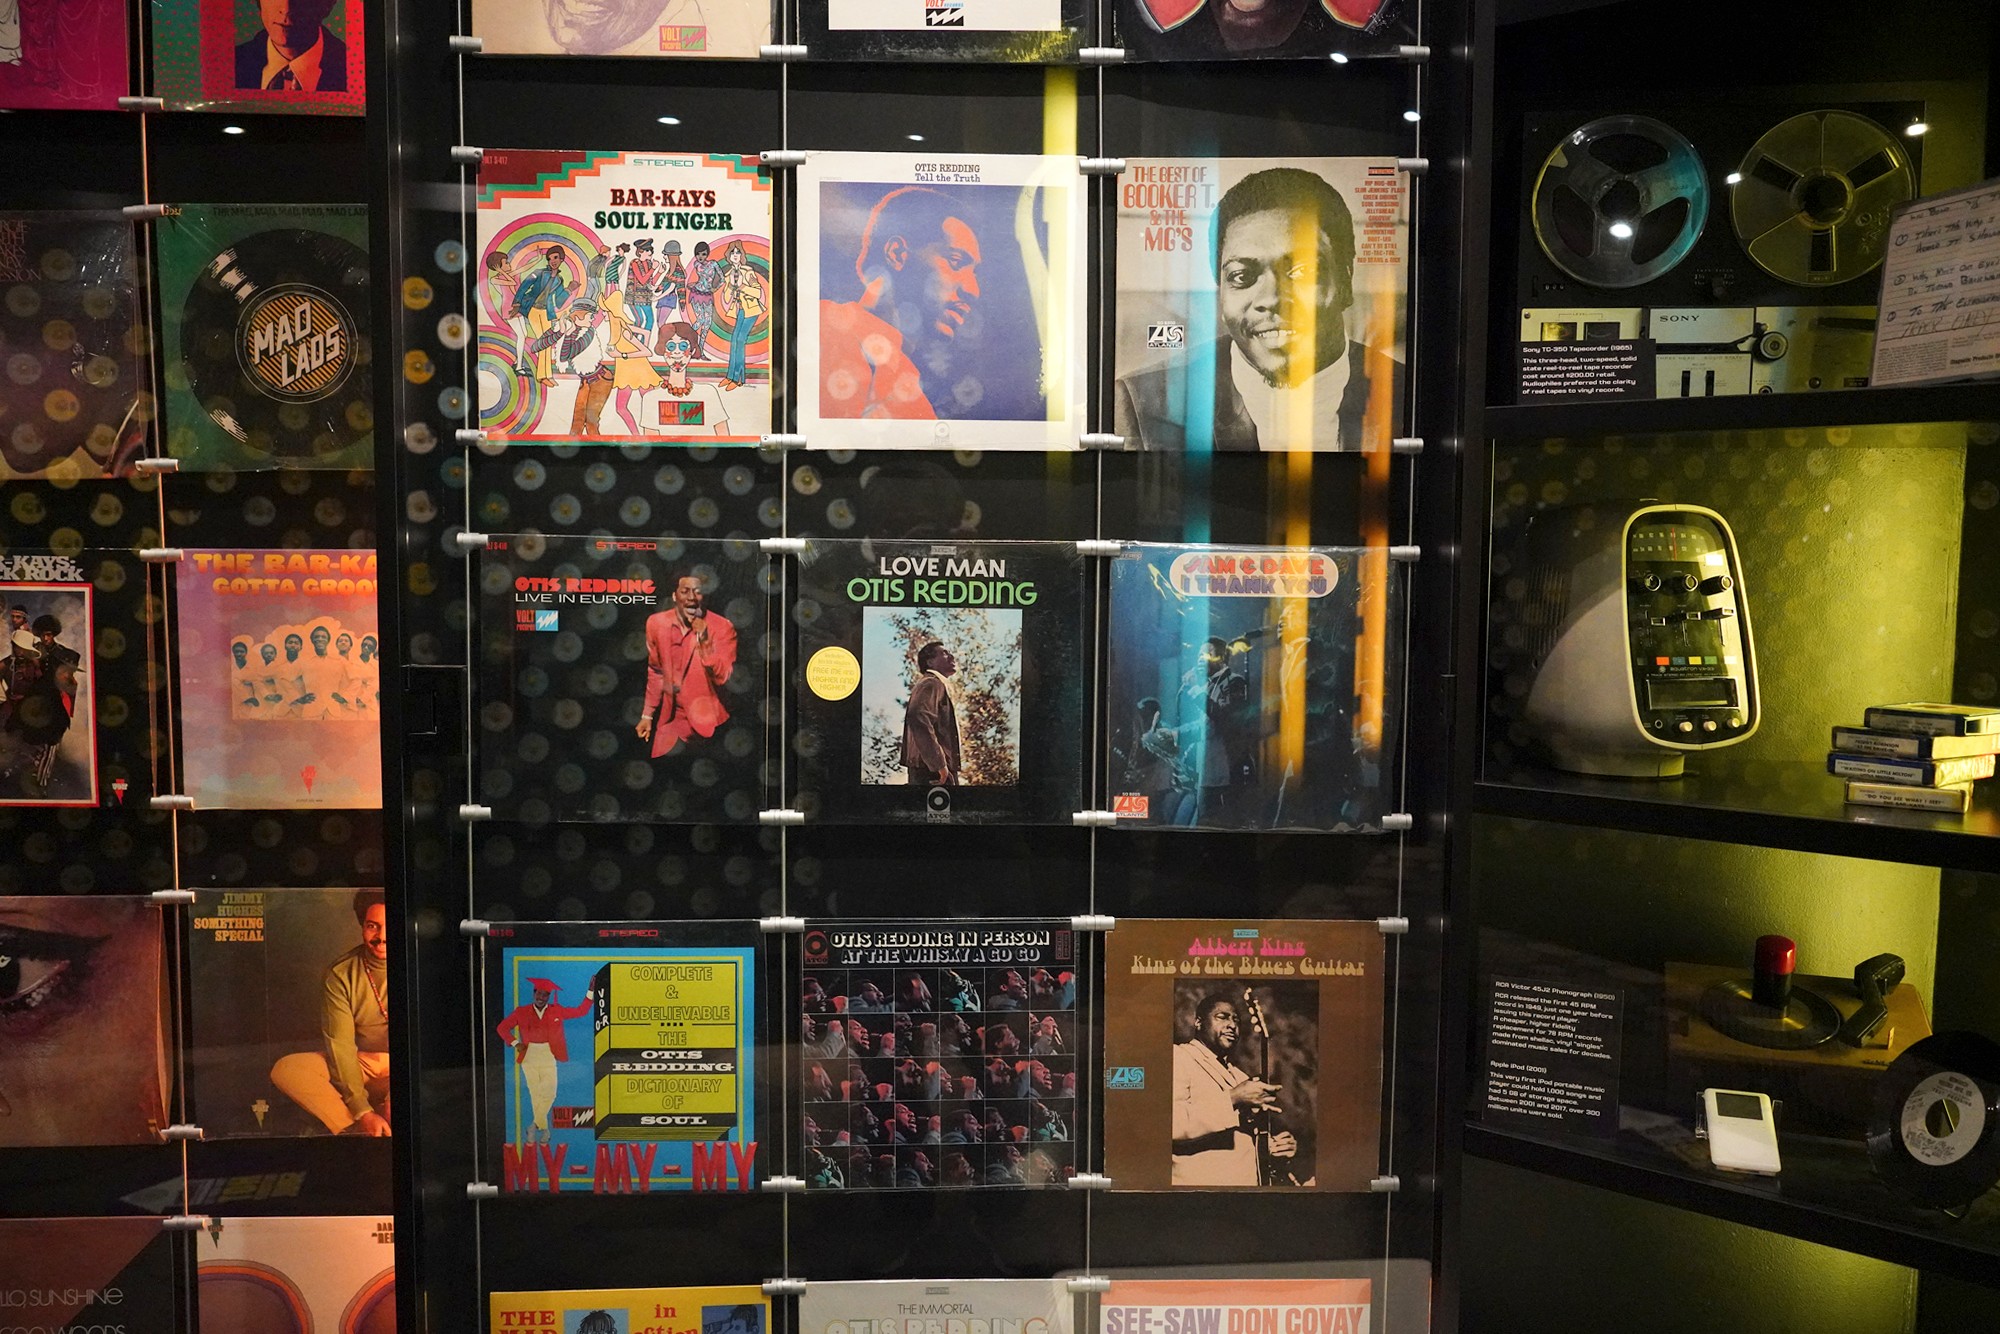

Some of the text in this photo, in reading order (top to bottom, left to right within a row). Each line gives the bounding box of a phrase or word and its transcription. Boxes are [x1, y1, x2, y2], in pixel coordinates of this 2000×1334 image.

[661, 27, 681, 41] VOLT
[633, 158, 695, 168] STEREO
[914, 163, 981, 173] OTIS REDDING
[914, 172, 981, 183] Tell the Truth
[1132, 166, 1208, 184] THE BEST OF
[609, 188, 717, 208] BAR-KAYS
[1123, 183, 1217, 209] BOOKER T.
[594, 211, 734, 231] SOUL FINGER
[1149, 209, 1188, 226] & THE
[1144, 227, 1193, 252] MG'S
[1659, 314, 1700, 322] SONY
[253, 302, 312, 366] MAD
[281, 323, 341, 388] LADS
[1563, 379, 1598, 387] preferred
[1613, 378, 1636, 386] clarity
[595, 541, 657, 551] STEREO
[192, 553, 255, 575] THE
[880, 557, 1006, 578] LOVE MAN
[1182, 555, 1236, 575] SAM
[1259, 556, 1324, 575] DAVE
[24, 566, 84, 582] ROCK
[212, 577, 378, 597] GOTTA GROO
[515, 576, 657, 595] OTIS REDDING
[846, 578, 1038, 606] OTIS REDDING
[1180, 574, 1328, 595] I THANK YOU
[515, 593, 657, 605] LIVE IN EUROPE
[516, 610, 535, 623] VOLT
[222, 892, 264, 905] JIMMY
[217, 905, 264, 917] HUGHES
[194, 917, 264, 930] SOMETHING
[214, 930, 265, 942] SPECIAL
[598, 929, 659, 937] STEREO
[830, 930, 1050, 948] OTIS REDDING IN PERSON
[1188, 937, 1307, 957] Albert King
[841, 947, 1041, 964] AT THE WHISKY A GO GO
[1131, 955, 1365, 977] King of the Blues Guitar
[630, 966, 713, 982] COMPLETE
[665, 985, 679, 999] &
[1552, 987, 1593, 998] Phonograph
[1593, 992, 1616, 1001] (1950)
[617, 1006, 731, 1021] UNBELIEVABLE
[1493, 1007, 1518, 1017] issuing
[1589, 1011, 1614, 1019] before
[657, 1031, 687, 1046] THE
[640, 1050, 704, 1060] OTIS
[611, 1062, 734, 1072] REDDING
[1490, 1060, 1547, 1074] Apple iPod (2001)
[626, 1078, 722, 1093] DICTIONARY
[661, 1096, 684, 1110] OF
[640, 1115, 708, 1126] SOUL
[654, 1303, 677, 1319] in
[897, 1303, 974, 1315] THE IMMORTAL
[499, 1310, 556, 1326] THE
[824, 1317, 898, 1334] OTIS
[1106, 1306, 1364, 1334] SEE-SAW DON COVAY
